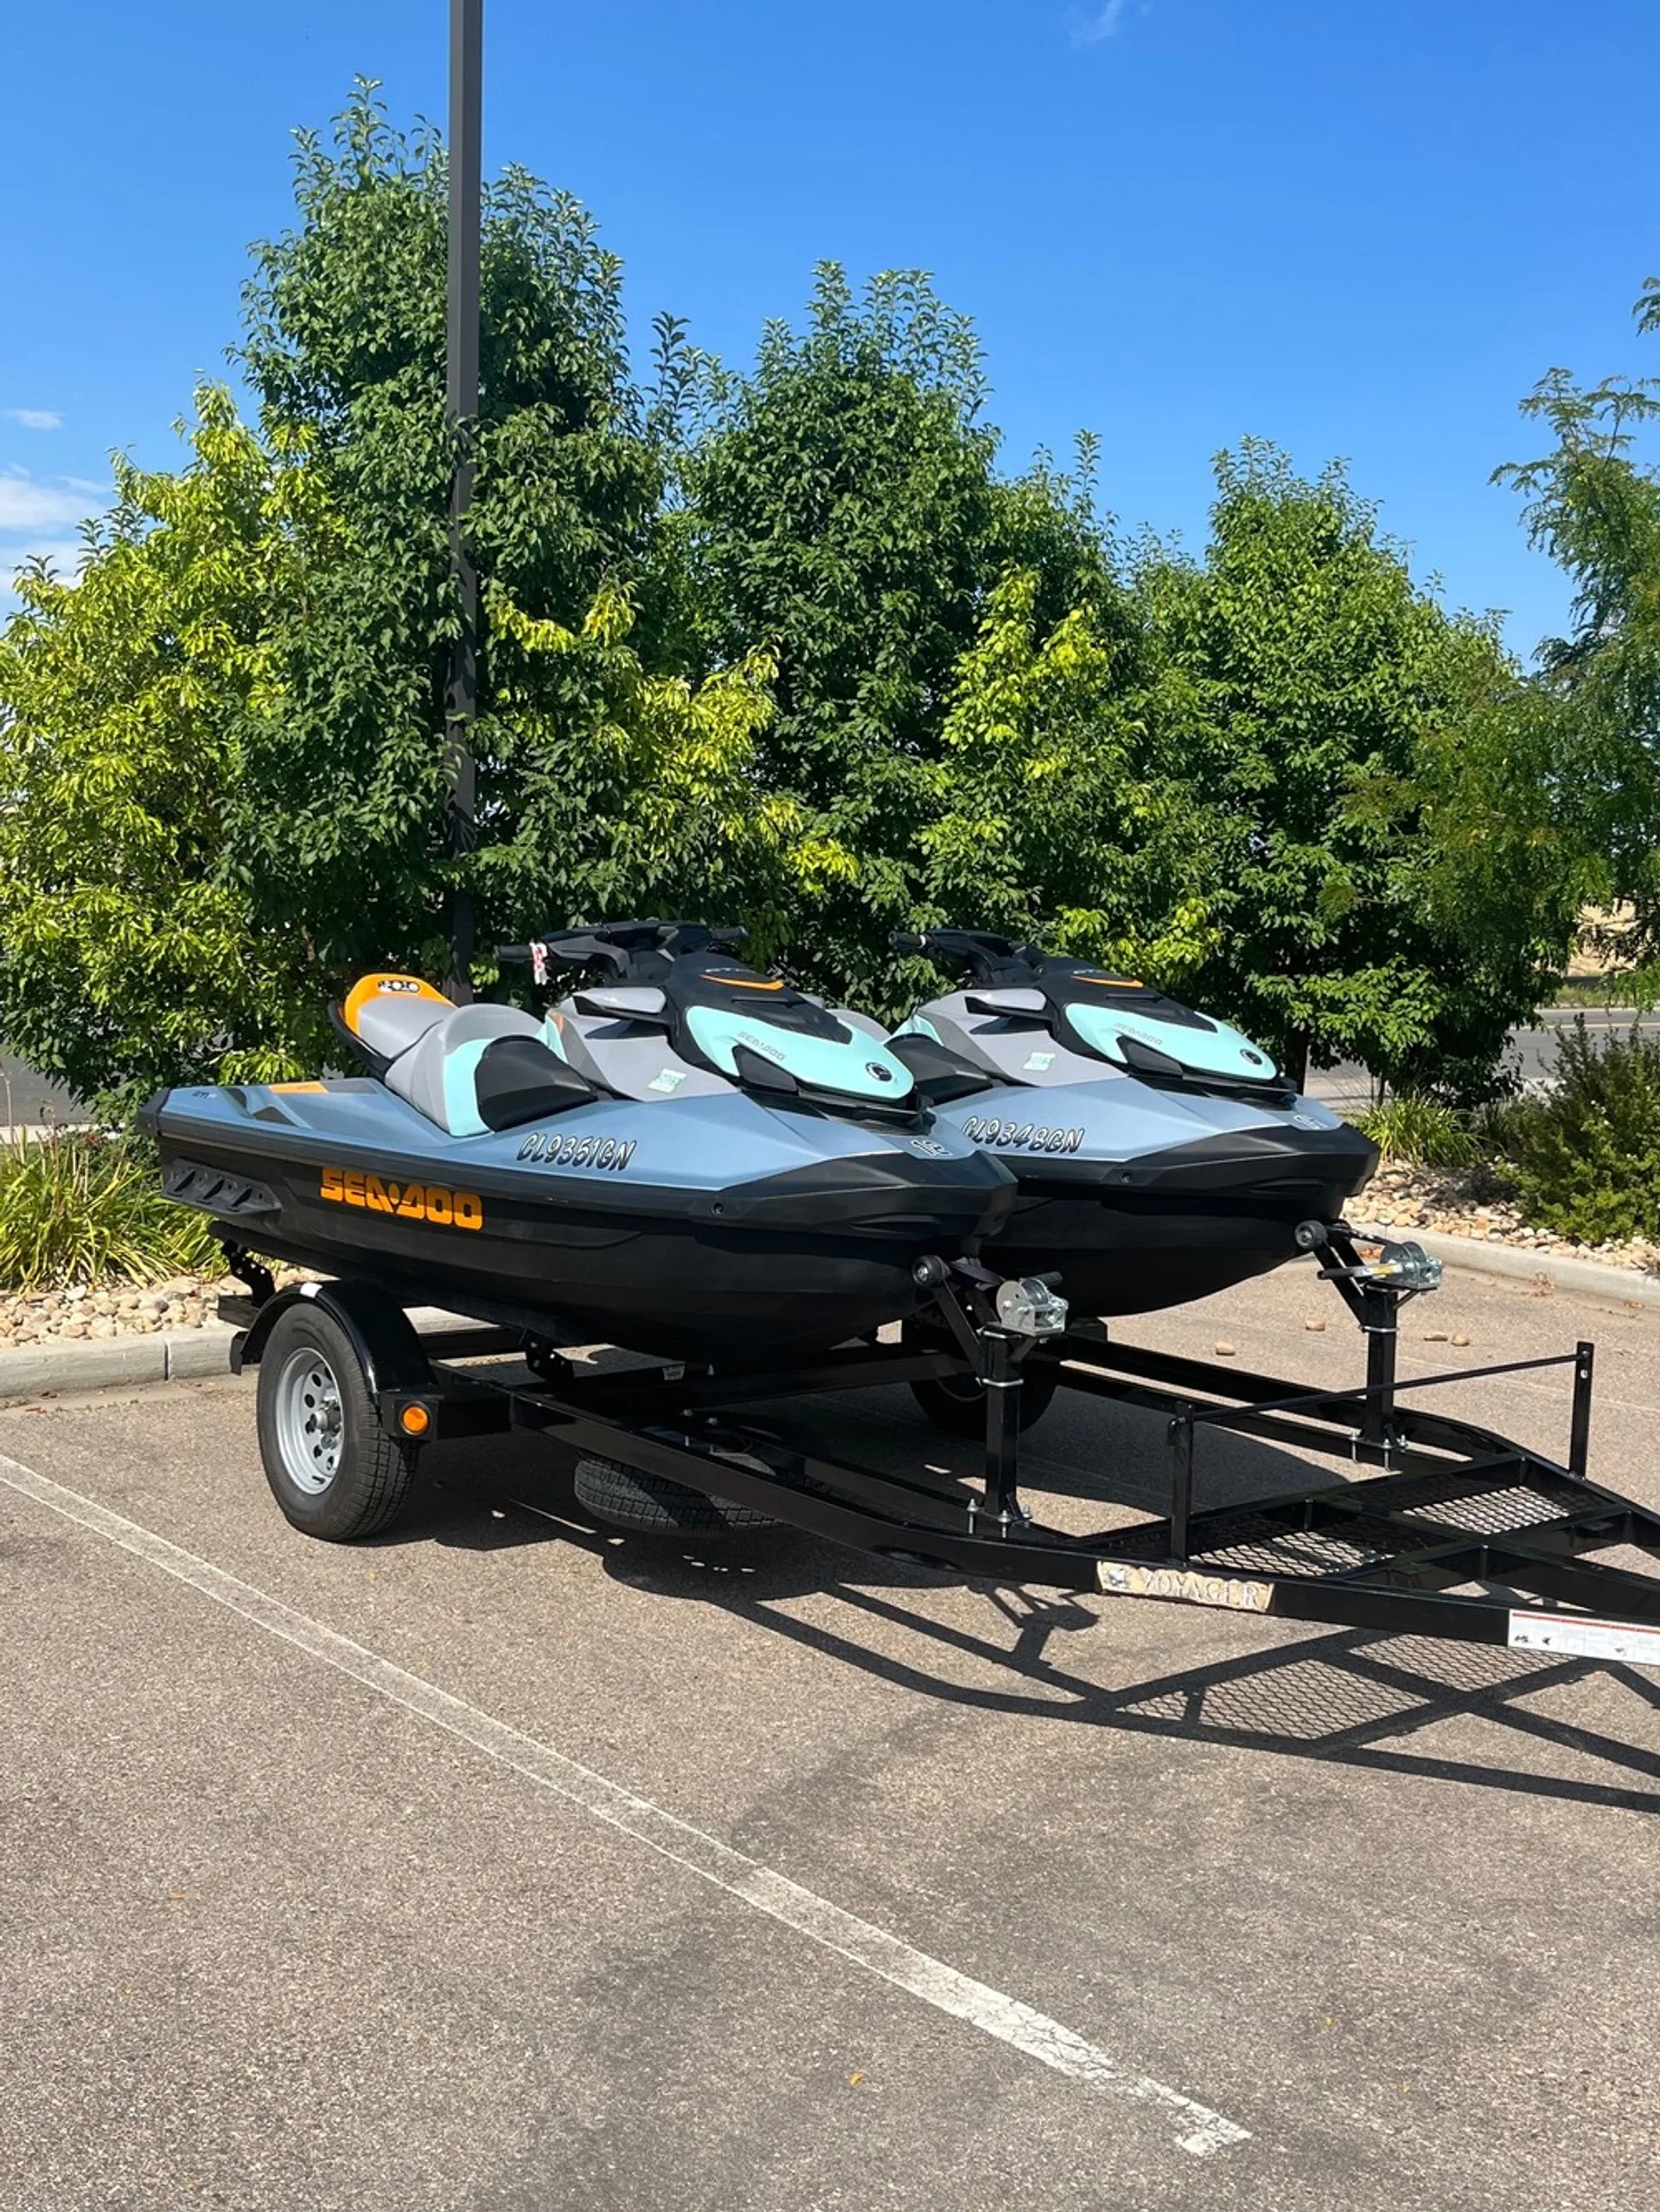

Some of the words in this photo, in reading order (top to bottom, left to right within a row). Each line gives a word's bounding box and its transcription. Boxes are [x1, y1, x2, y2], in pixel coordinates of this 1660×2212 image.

[515, 1132, 637, 1171] CL9351GN
[961, 1116, 1085, 1154] CL9348GN
[1140, 1571, 1260, 1610] VOYAGER
